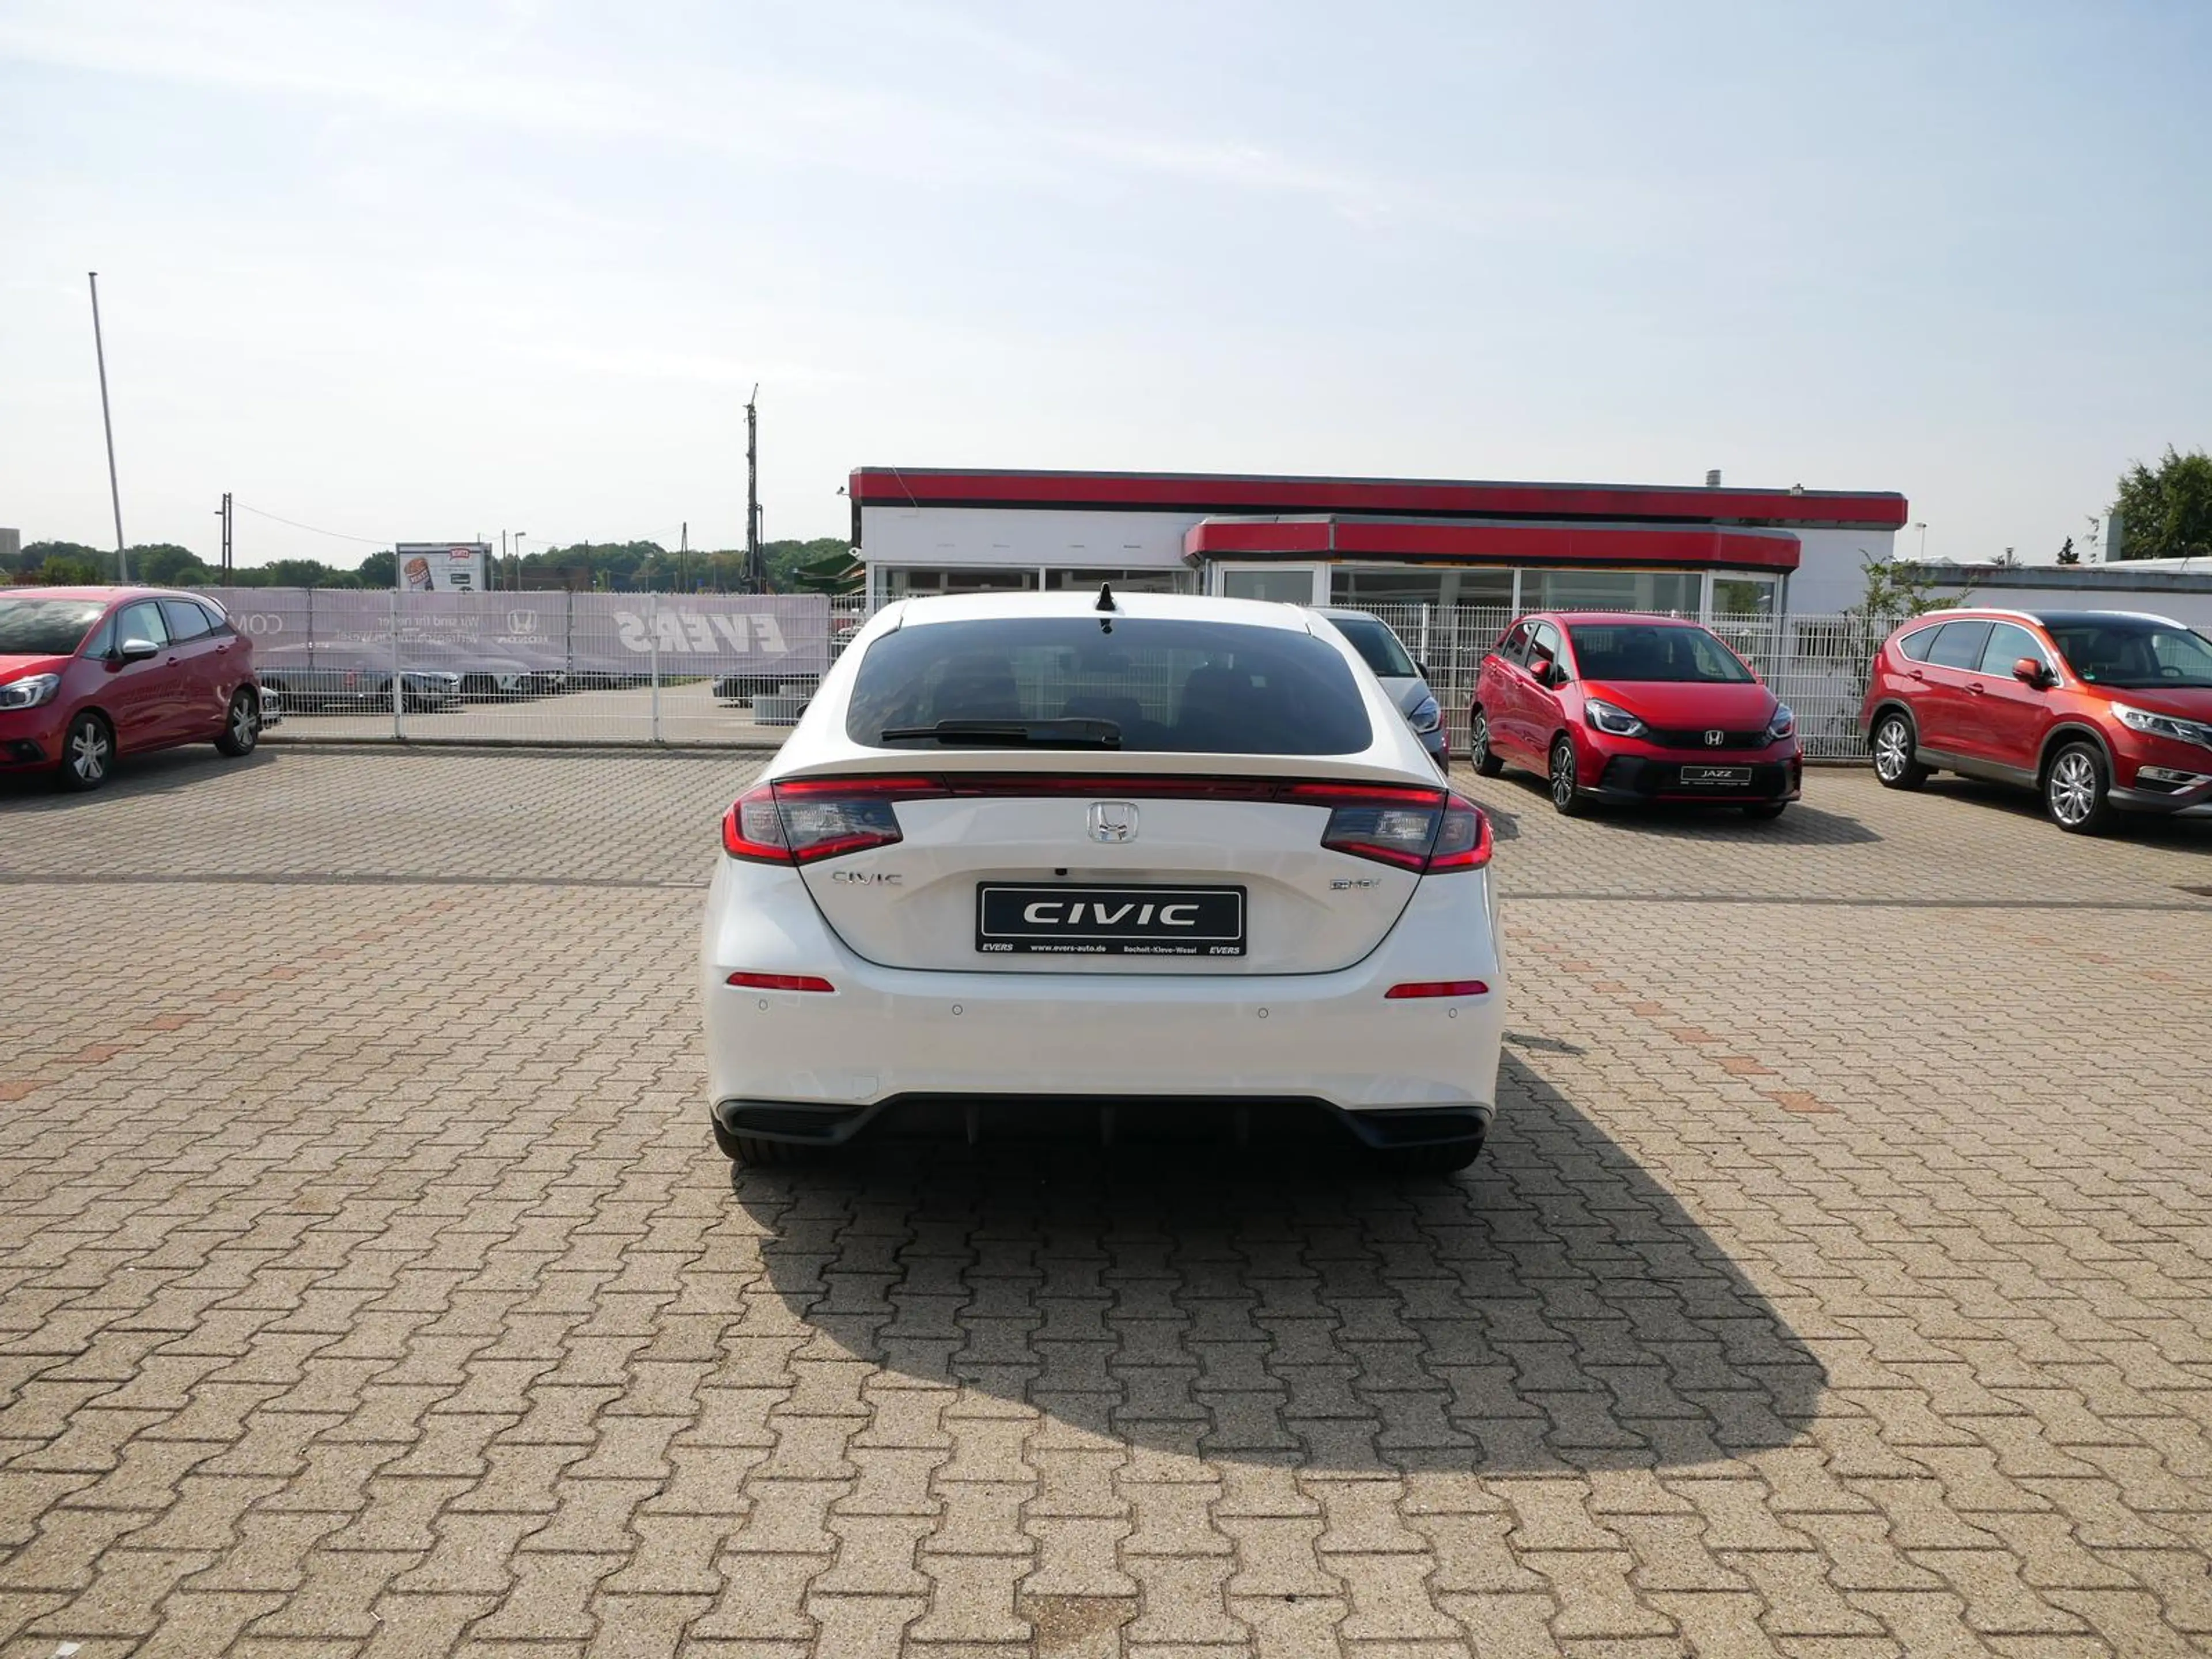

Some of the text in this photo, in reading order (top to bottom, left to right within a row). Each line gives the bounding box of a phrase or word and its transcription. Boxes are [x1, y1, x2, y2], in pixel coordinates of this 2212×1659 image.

[832, 871, 903, 885] CIVIC
[1024, 903, 1200, 925] CIVIC
[1210, 946, 1240, 955] EVERS
